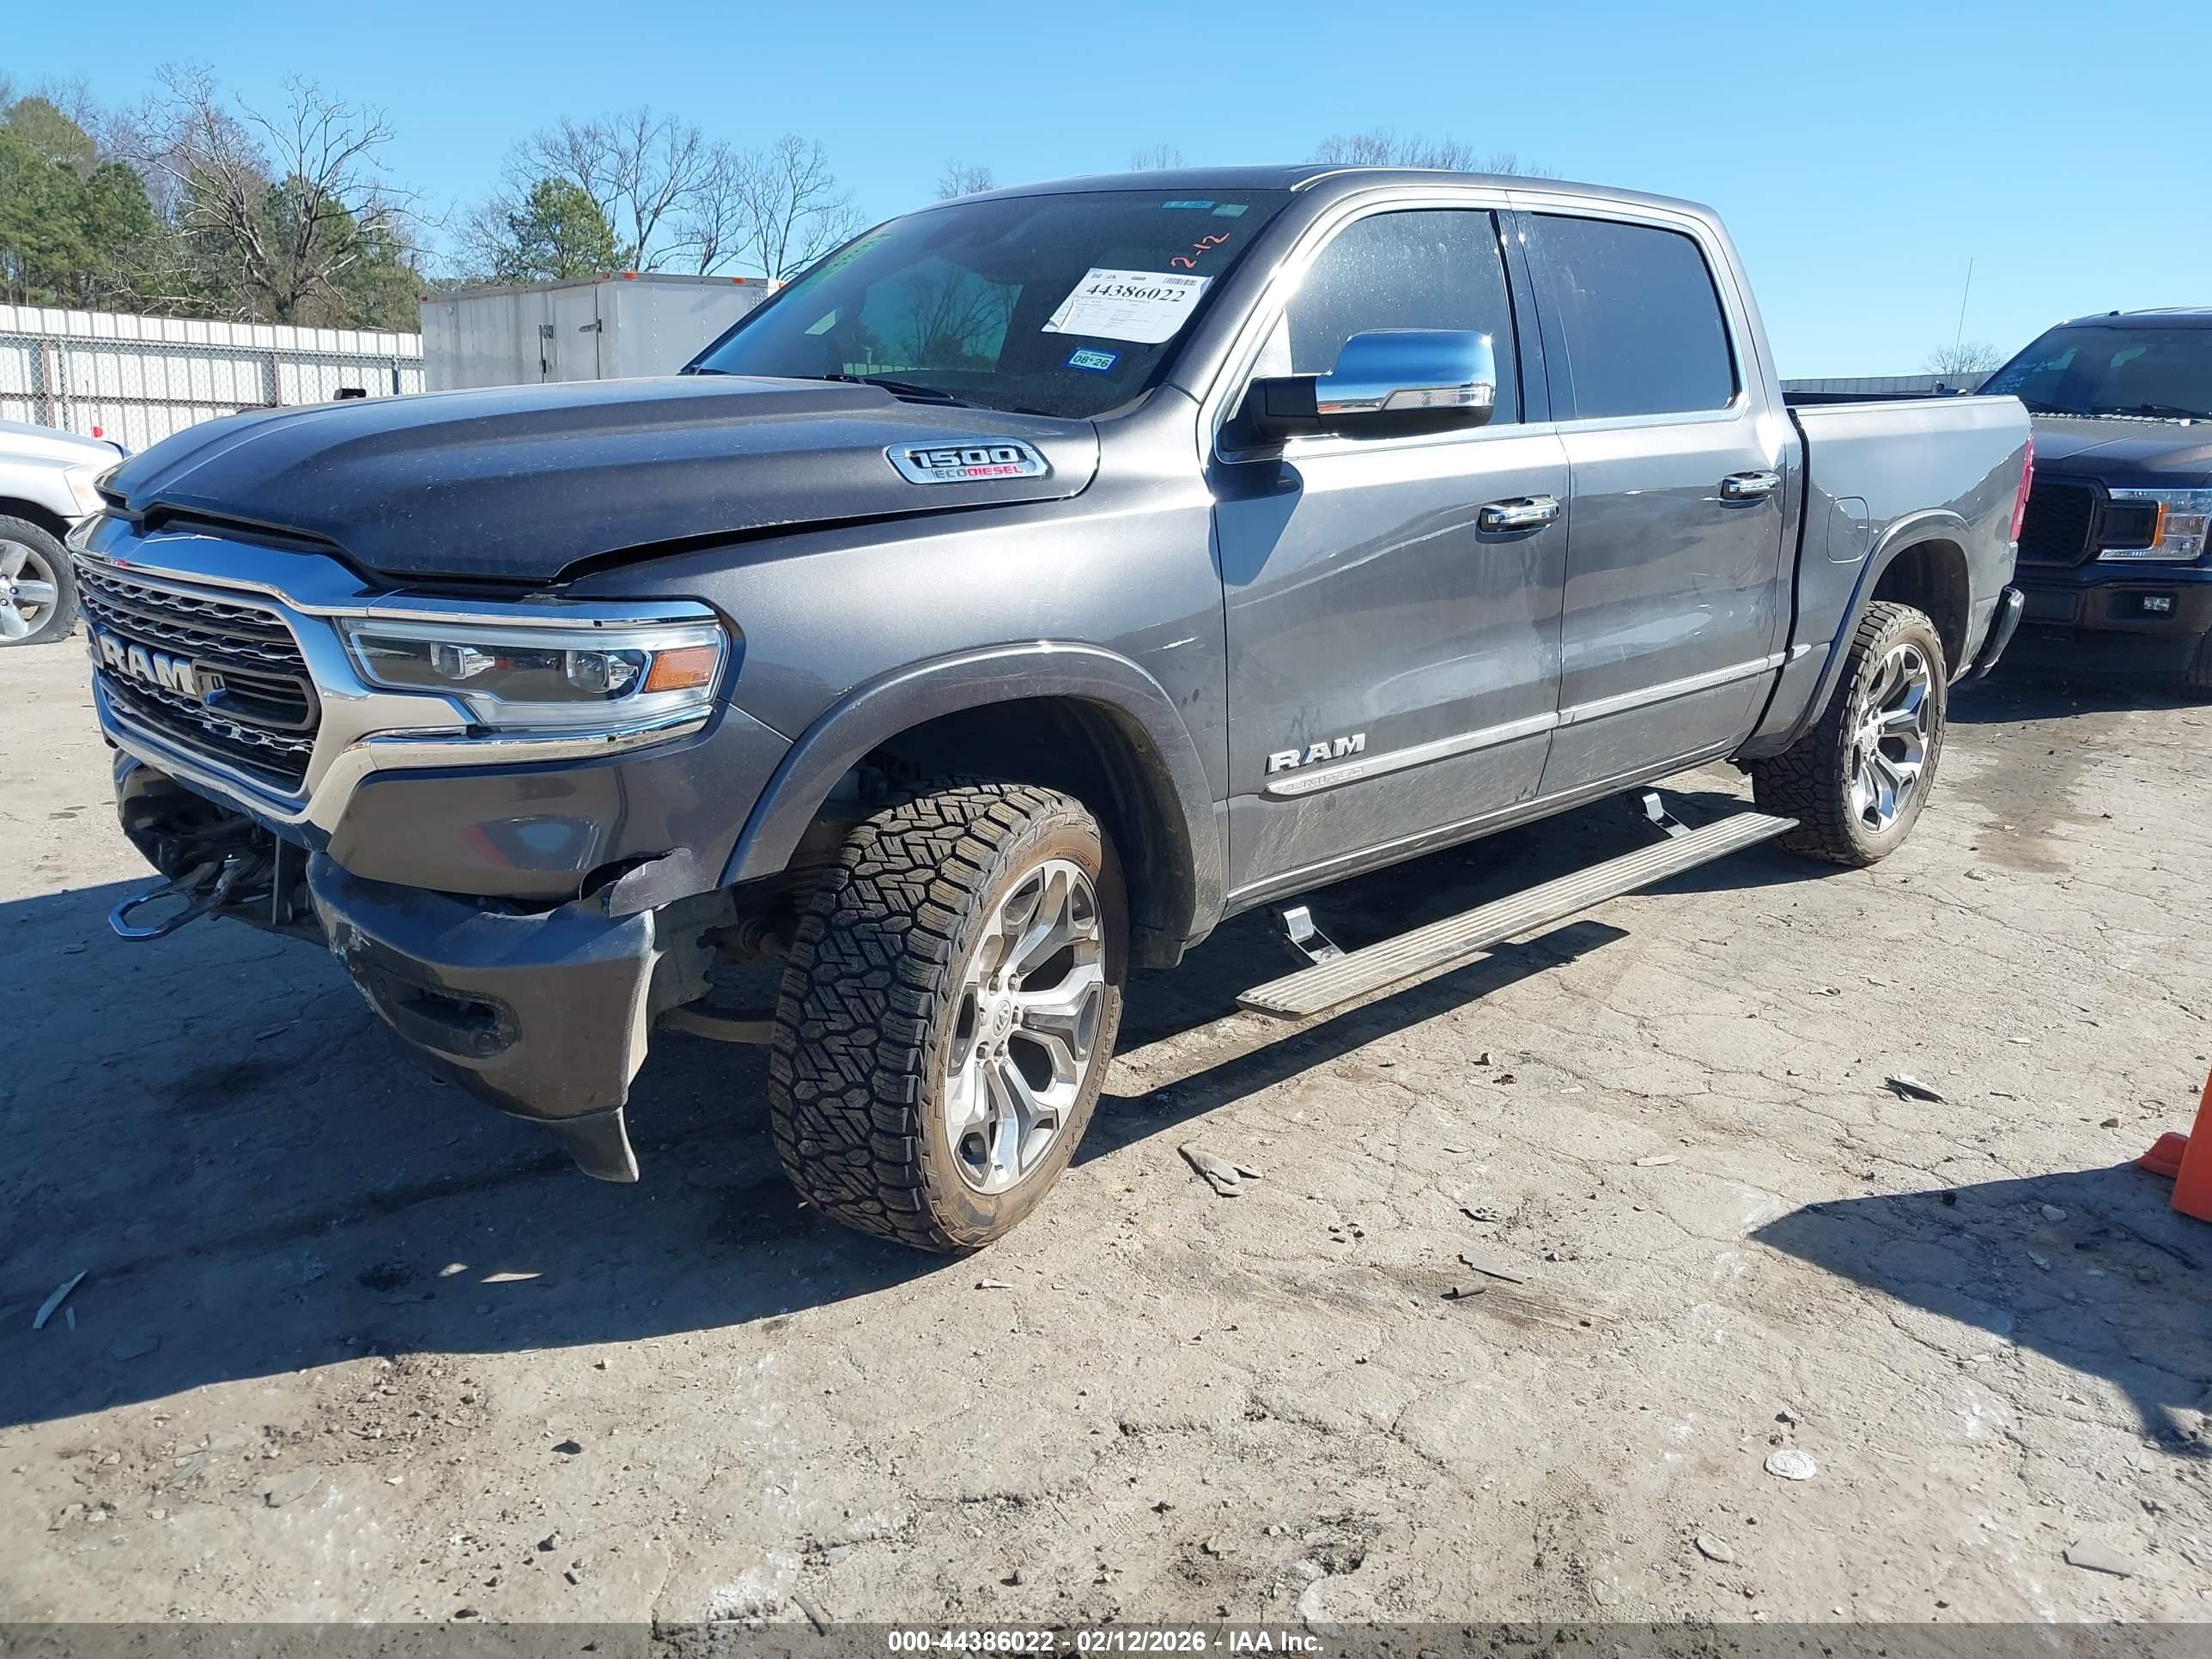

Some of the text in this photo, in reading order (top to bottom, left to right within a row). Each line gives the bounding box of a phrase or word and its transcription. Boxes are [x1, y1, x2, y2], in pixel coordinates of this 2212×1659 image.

[1086, 283, 1186, 302] 44386022
[1093, 358, 1110, 368] 26
[912, 447, 1019, 468] 1500
[933, 465, 1024, 481] ECODIESEL
[98, 632, 198, 696] RAM
[1267, 732, 1366, 775] RAM
